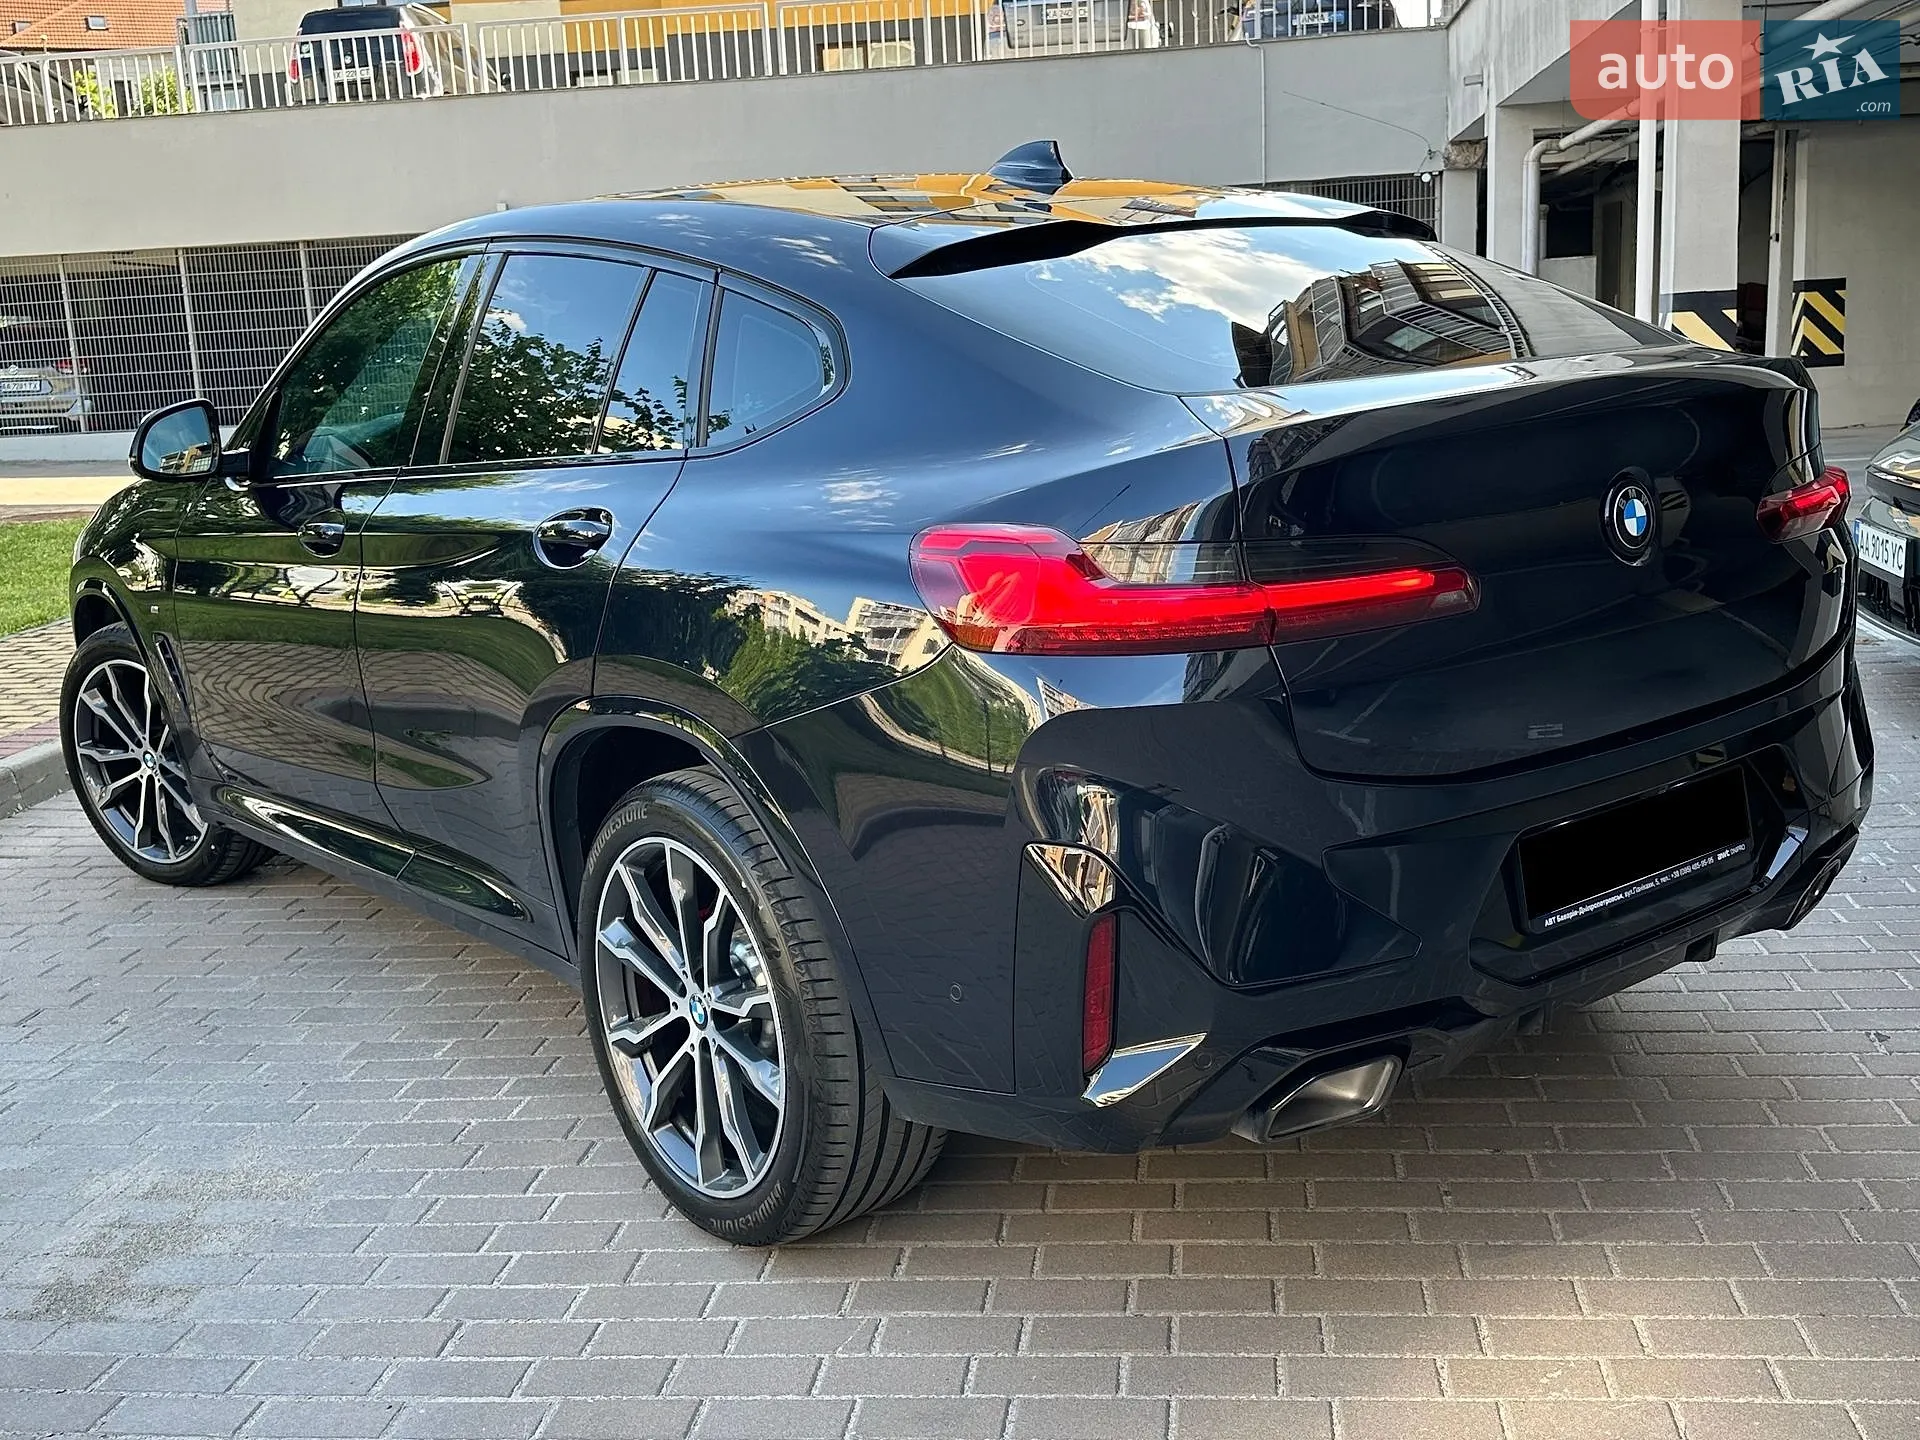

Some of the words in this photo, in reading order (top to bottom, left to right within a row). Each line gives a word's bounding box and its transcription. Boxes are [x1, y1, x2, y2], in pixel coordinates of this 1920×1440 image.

[1618, 488, 1649, 510] BMW
[1860, 530, 1869, 557] AA
[1871, 534, 1888, 564] 9015
[1892, 542, 1903, 571] YC
